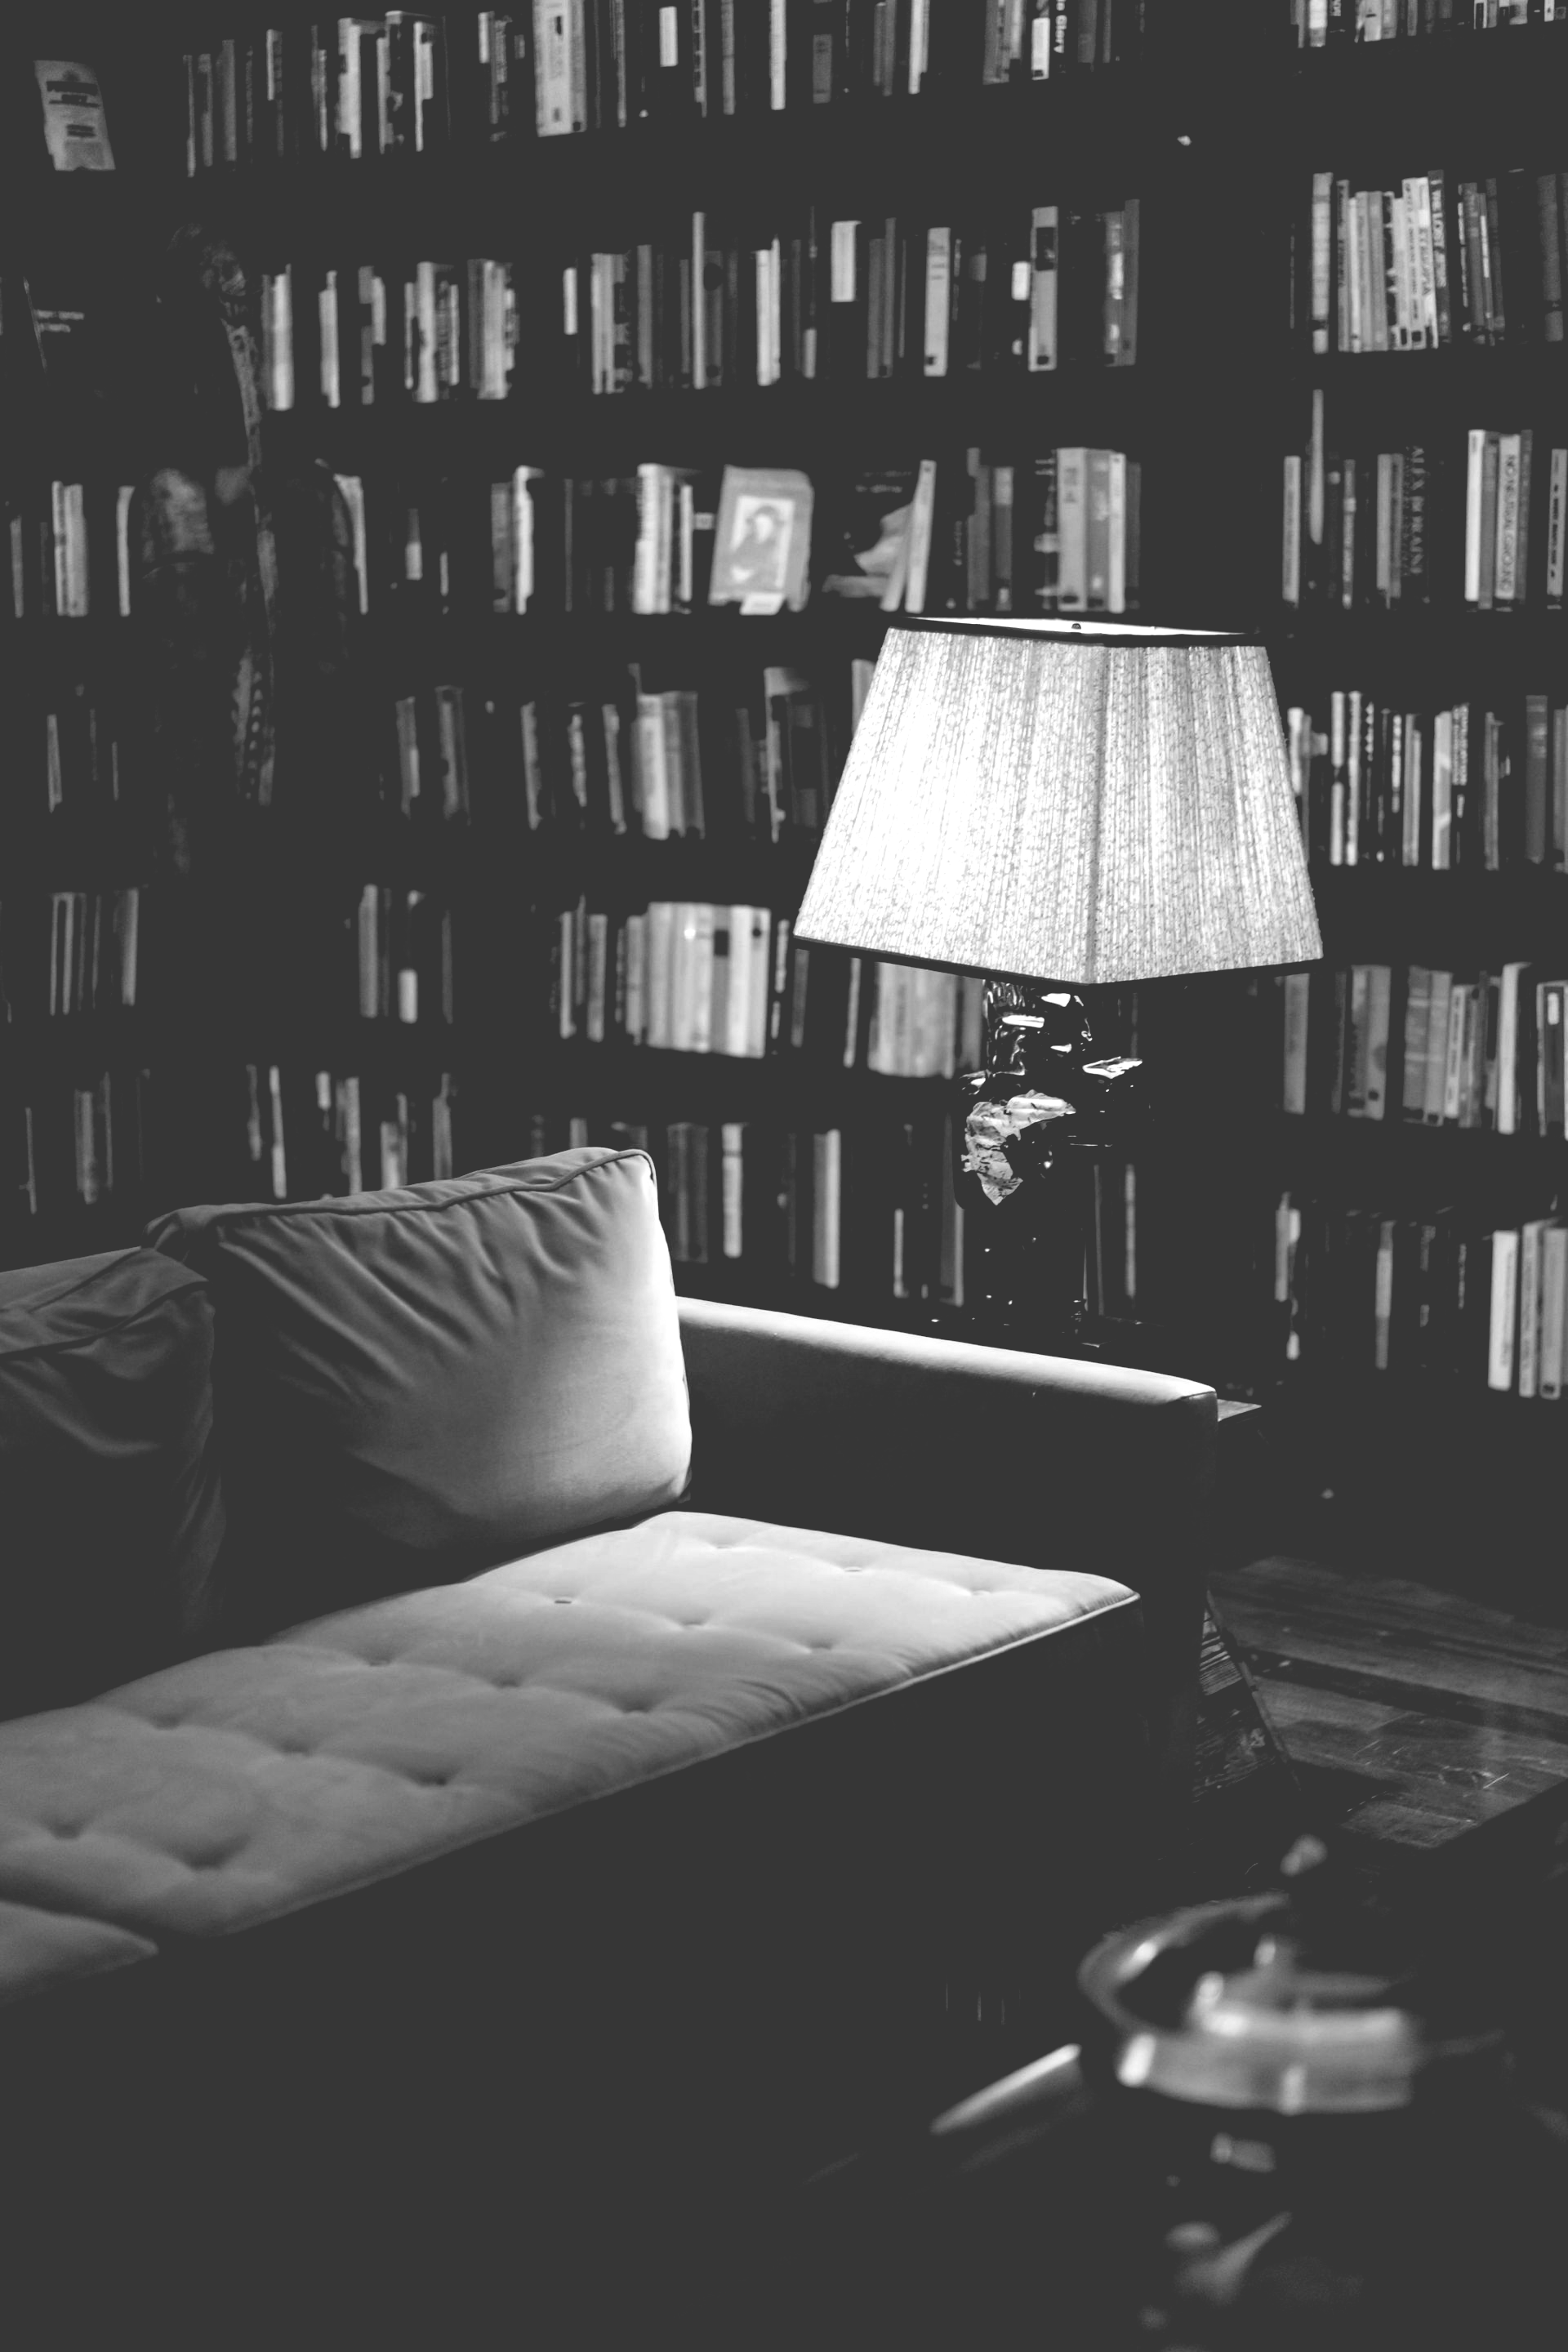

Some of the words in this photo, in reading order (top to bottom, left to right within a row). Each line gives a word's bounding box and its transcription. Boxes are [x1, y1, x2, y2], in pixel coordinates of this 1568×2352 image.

[1054, 15, 1067, 54] Glory
[1411, 445, 1425, 491] ALEX
[1506, 455, 1517, 476] NO
[1500, 536, 1515, 591] GROUND
